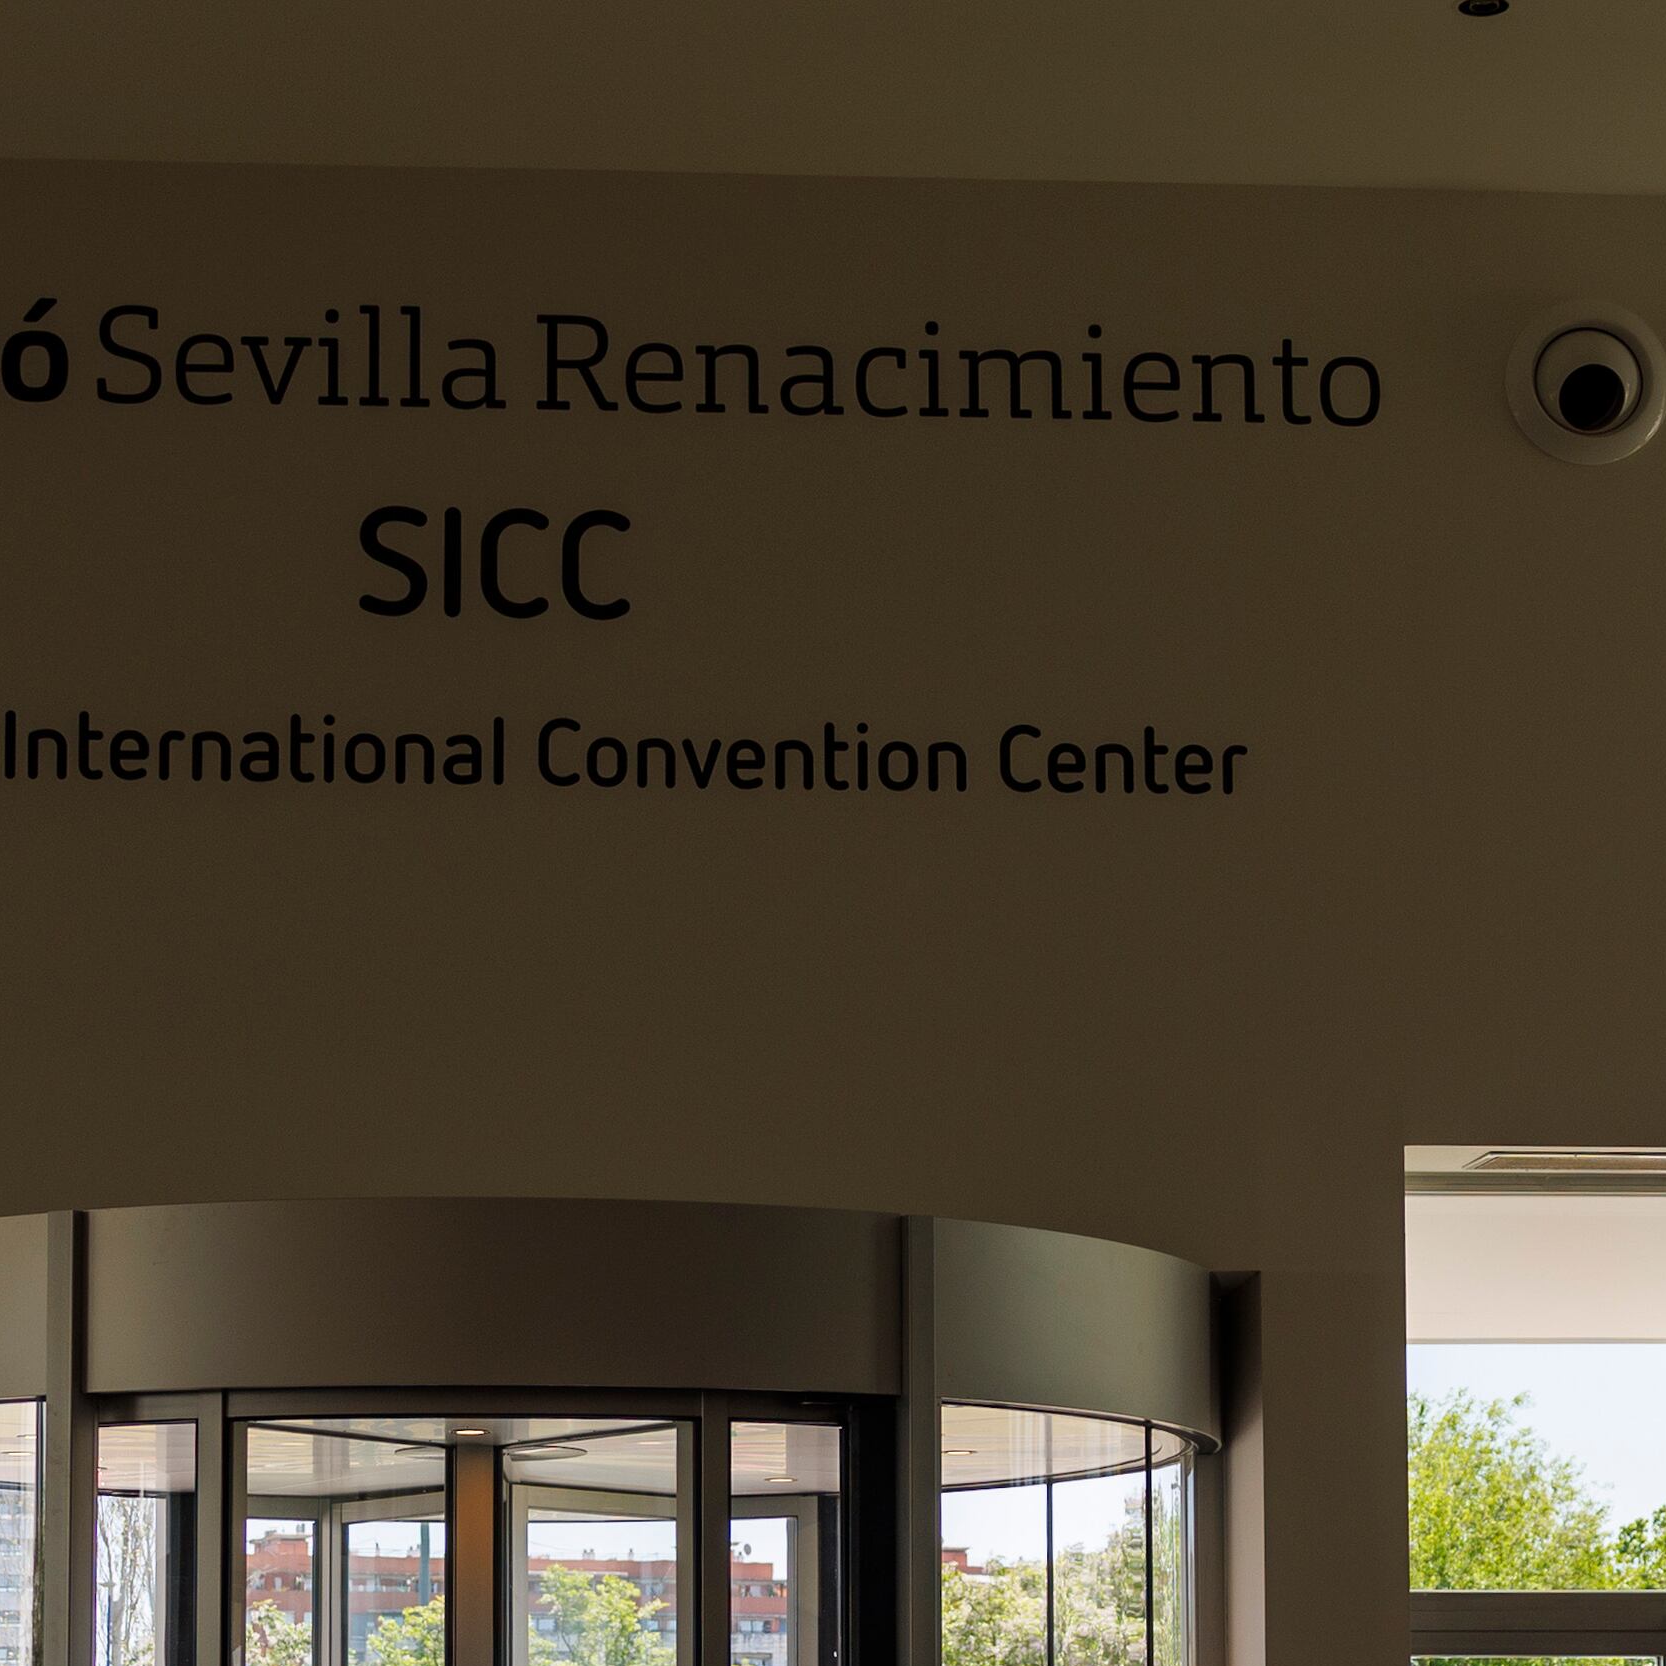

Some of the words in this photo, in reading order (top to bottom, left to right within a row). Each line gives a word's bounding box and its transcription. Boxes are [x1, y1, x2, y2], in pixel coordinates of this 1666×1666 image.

[96, 304, 507, 411] Sevilla
[536, 314, 1381, 427] Renacimiento
[358, 505, 631, 621] SICC
[4, 709, 505, 786] International
[537, 717, 967, 793] Convention
[999, 724, 1248, 795] Center
